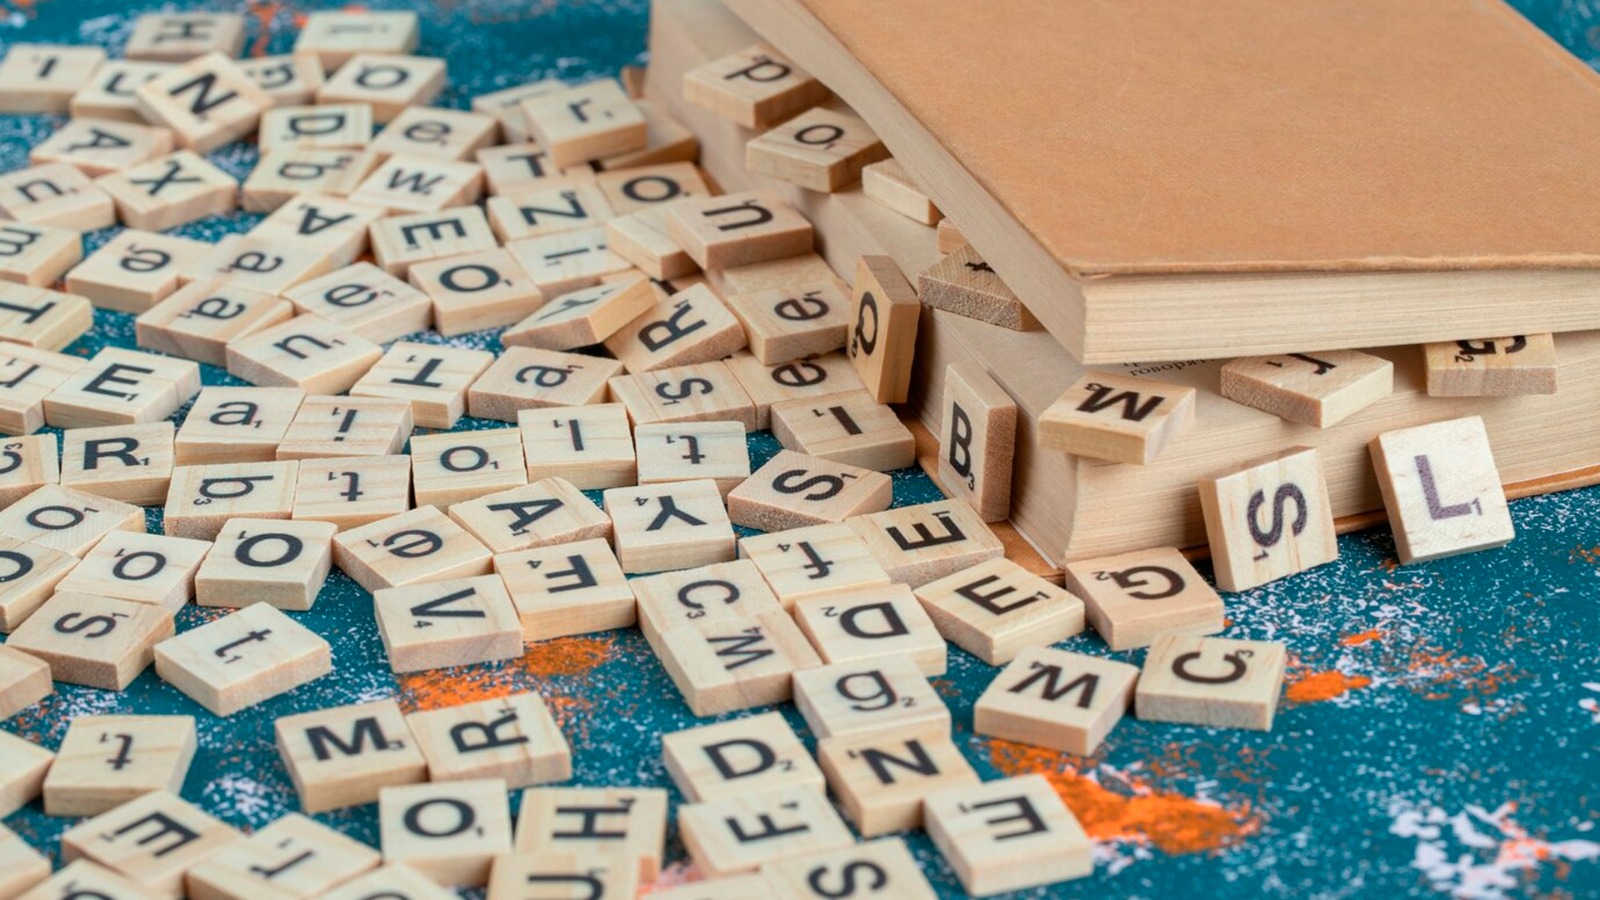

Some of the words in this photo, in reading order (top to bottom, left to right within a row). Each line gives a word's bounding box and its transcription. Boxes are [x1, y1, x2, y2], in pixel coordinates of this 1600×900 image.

[81, 362, 156, 399] E
[83, 436, 142, 471] R
[1414, 454, 1472, 521] L
[884, 513, 969, 552] E
[543, 553, 599, 594] F
[953, 573, 1043, 616] E
[449, 711, 531, 755] R
